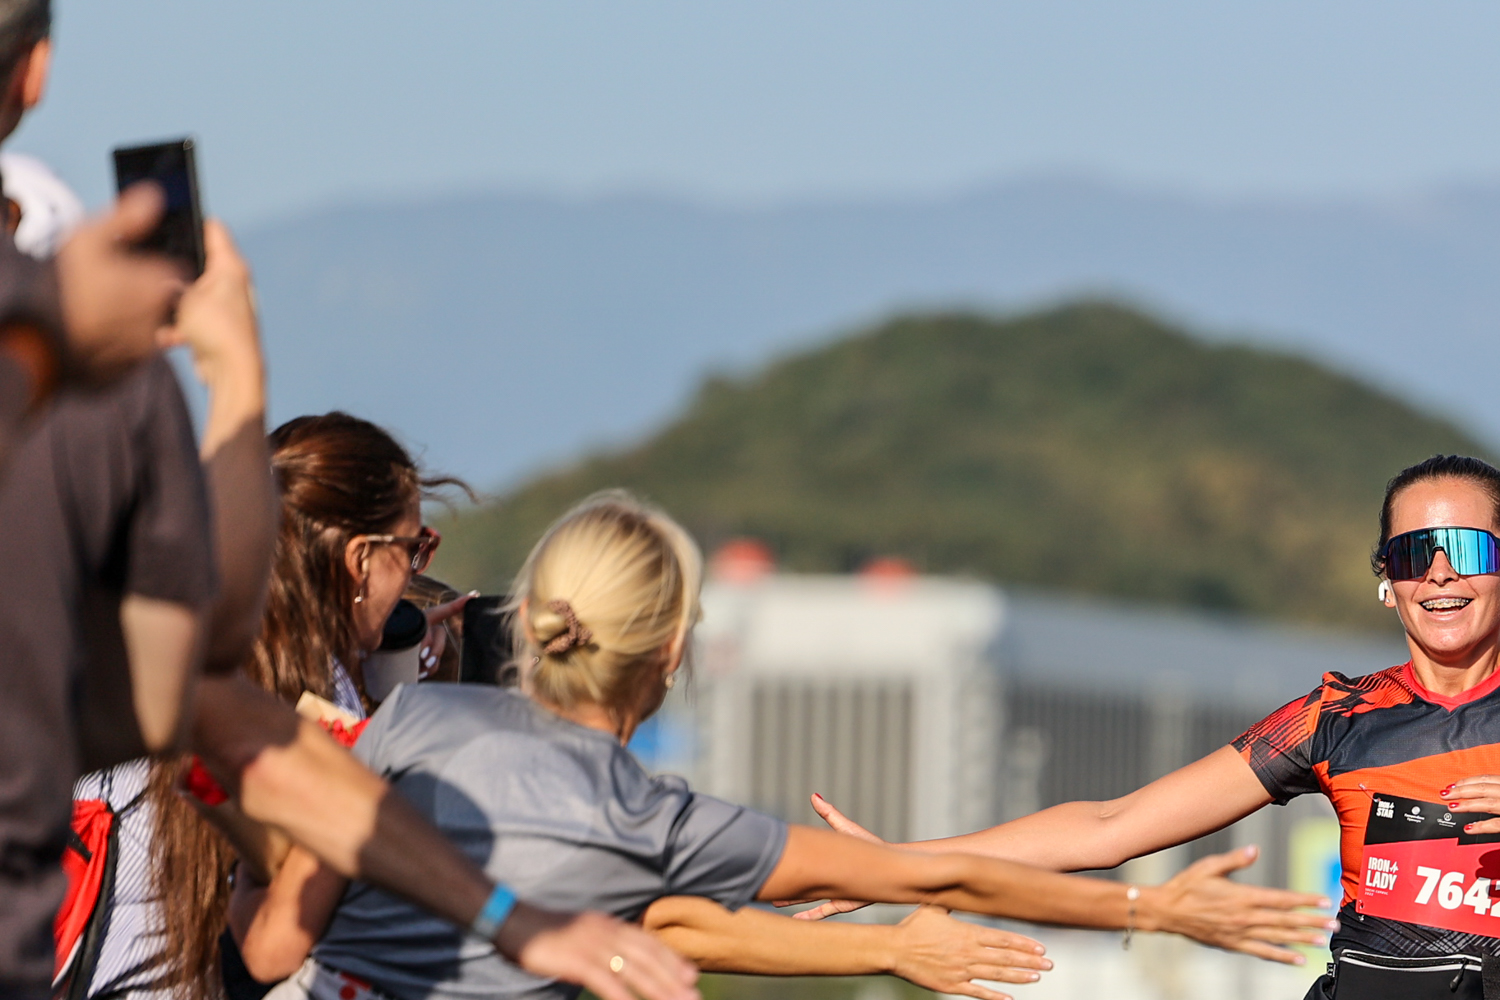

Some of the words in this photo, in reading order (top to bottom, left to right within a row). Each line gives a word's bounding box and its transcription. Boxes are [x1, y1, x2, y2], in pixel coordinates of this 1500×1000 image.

[1376, 808, 1394, 819] STAR
[1368, 856, 1391, 872] IRON
[1366, 870, 1398, 890] LADY
